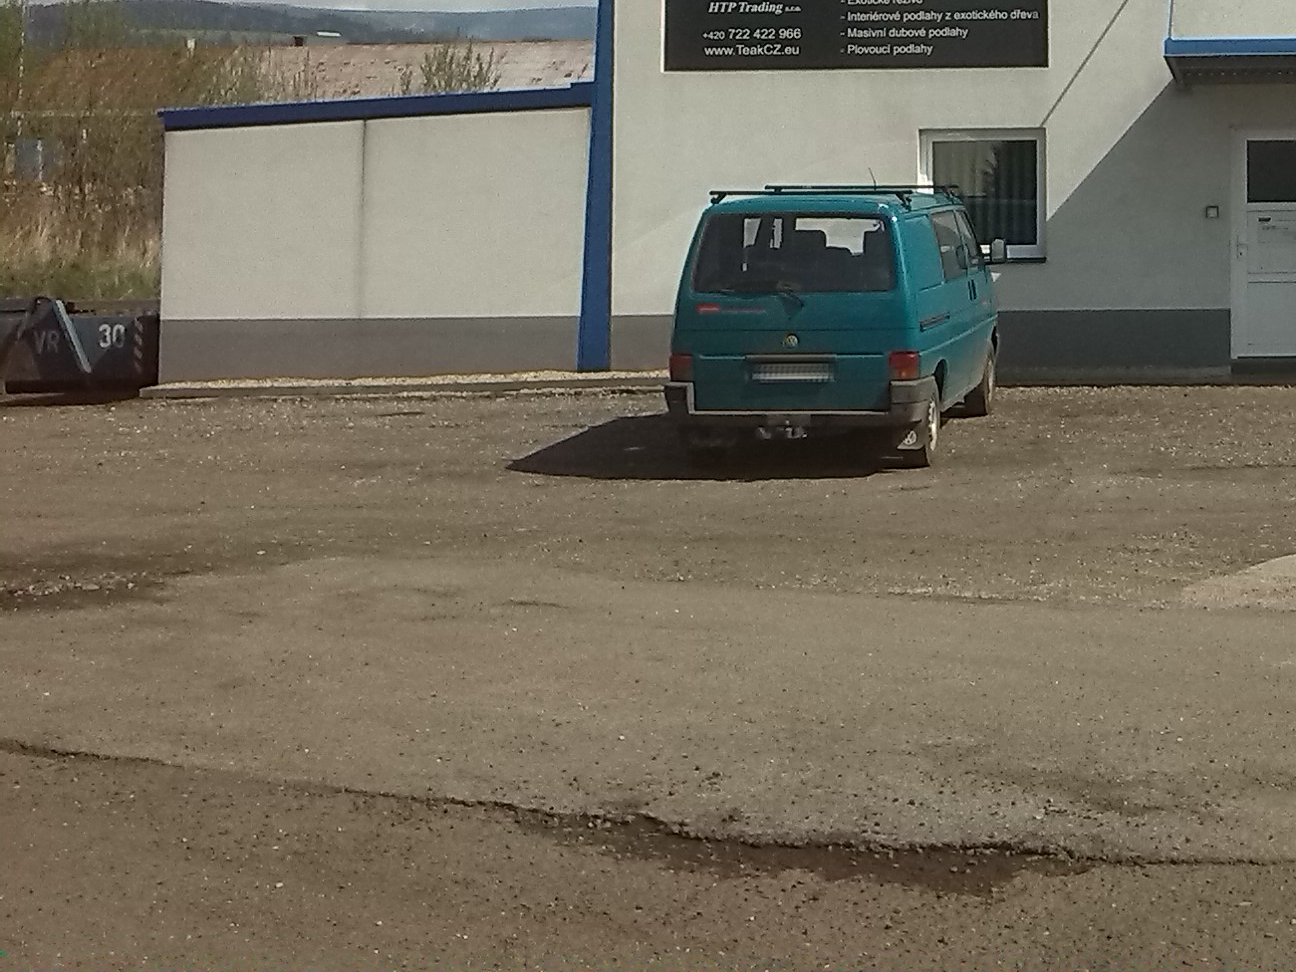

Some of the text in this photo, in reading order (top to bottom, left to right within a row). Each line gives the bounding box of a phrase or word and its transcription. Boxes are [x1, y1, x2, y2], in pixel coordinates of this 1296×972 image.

[708, 1, 737, 13] HTP
[738, 1, 784, 15] Trading
[847, 9, 1039, 23] Interiérové podlahy z exotického dřeva
[702, 28, 802, 40] +420 722 422 966
[847, 26, 968, 39] Masivní dubové podlahy
[704, 43, 800, 56] www.TeakCZ.eu
[847, 43, 933, 56] Plovoucí podlahy
[99, 323, 126, 349] 30
